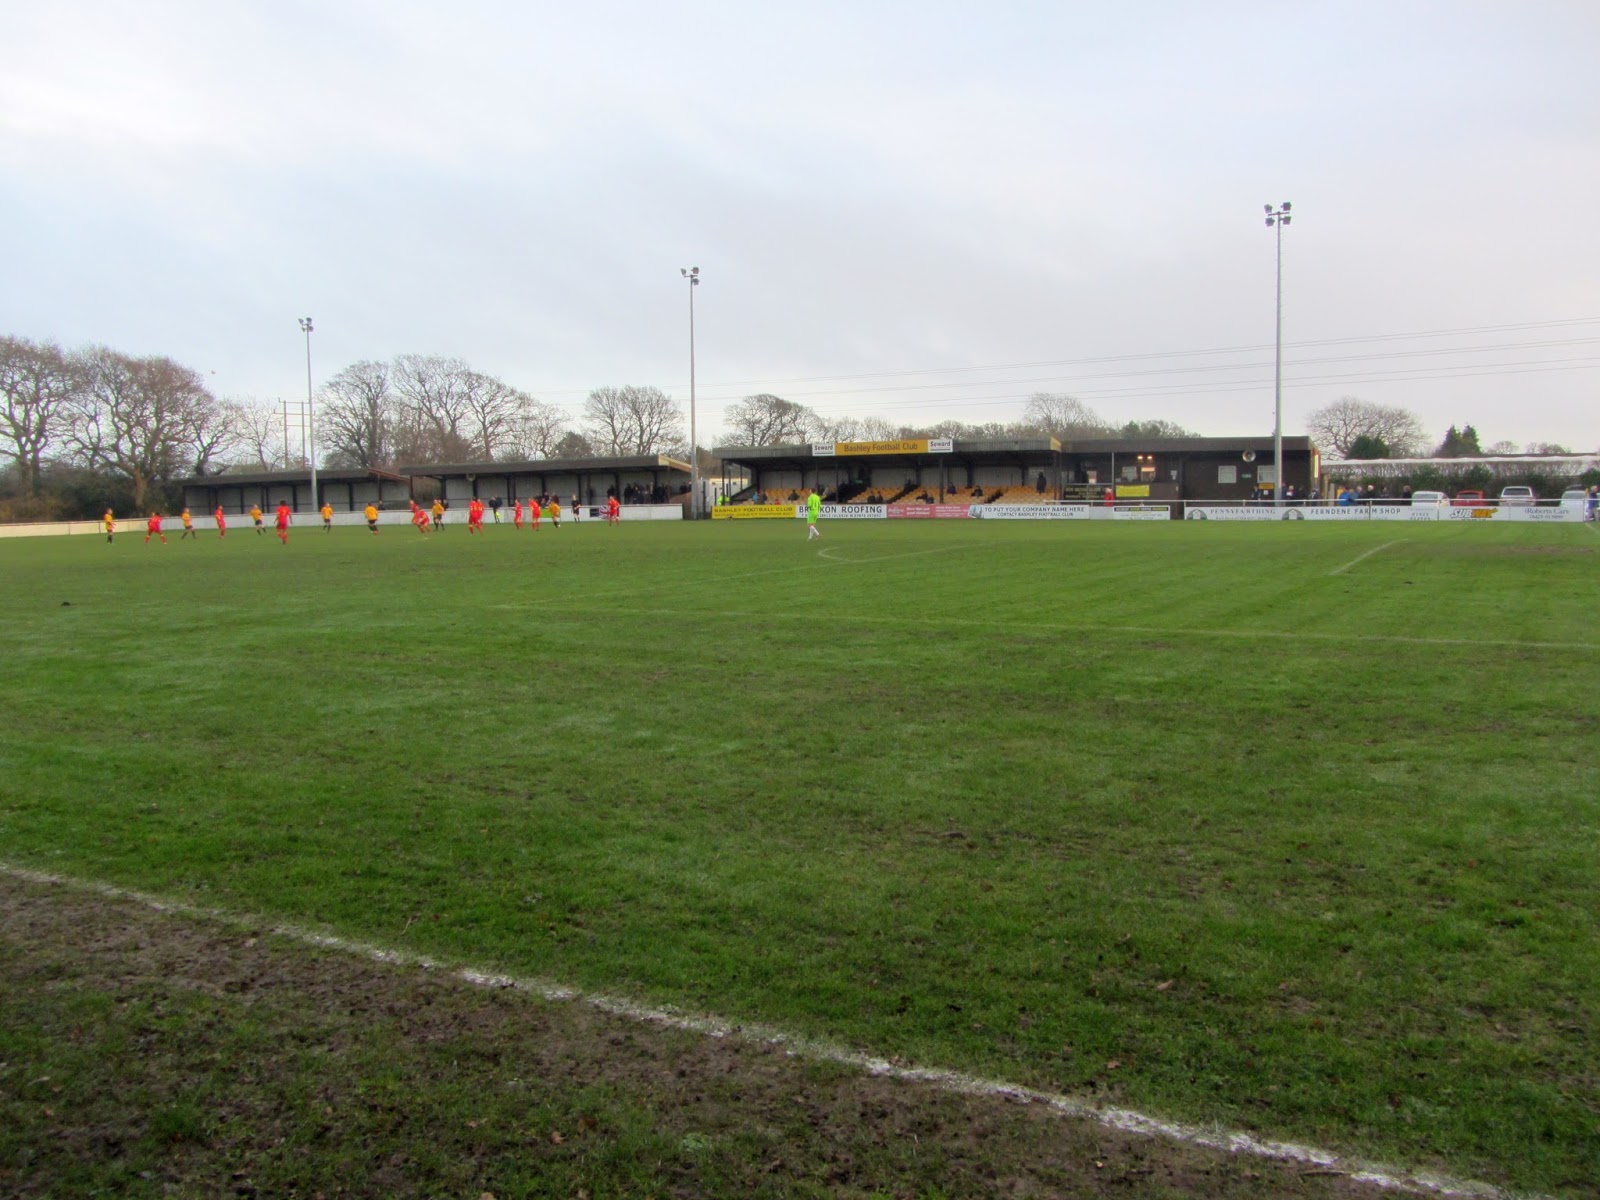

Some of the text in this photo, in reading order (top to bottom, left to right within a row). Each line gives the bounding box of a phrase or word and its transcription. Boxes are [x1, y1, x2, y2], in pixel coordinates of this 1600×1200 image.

[872, 443, 900, 451] Football
[902, 442, 918, 450] Club
[841, 506, 882, 514] ROOFING
